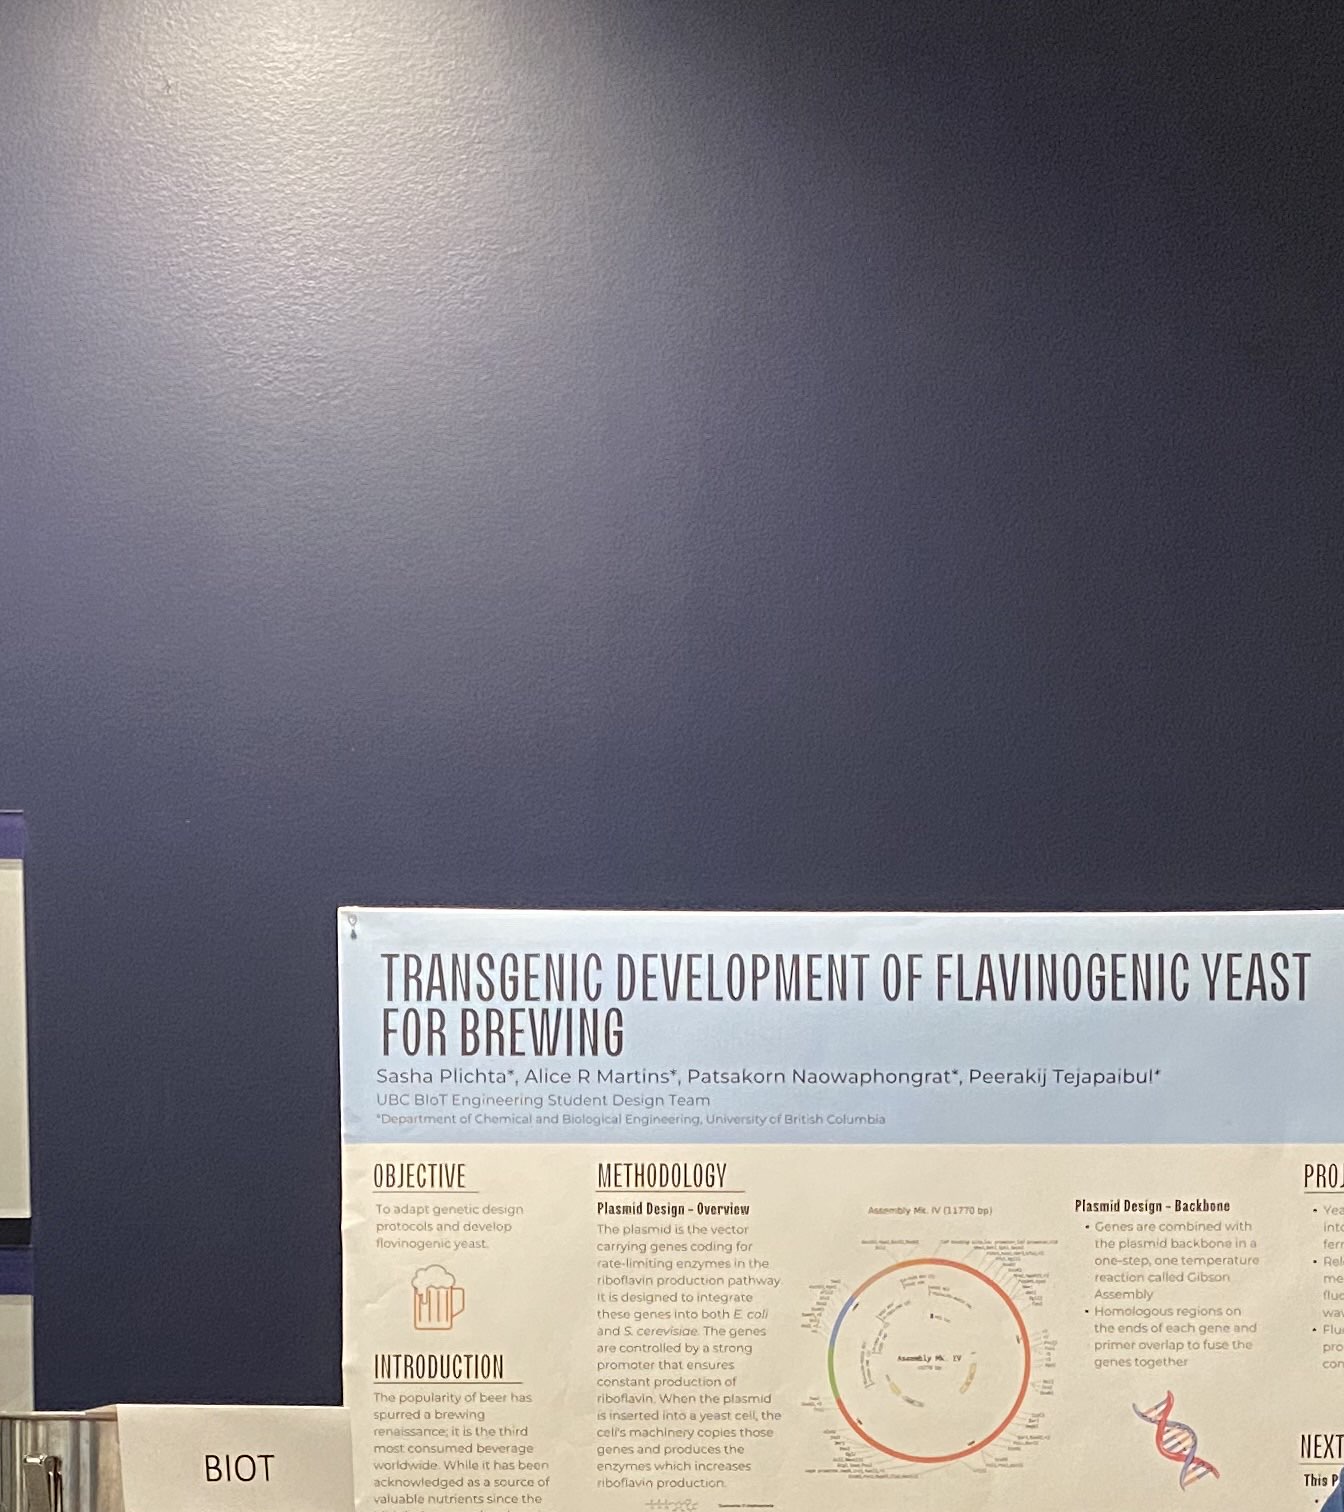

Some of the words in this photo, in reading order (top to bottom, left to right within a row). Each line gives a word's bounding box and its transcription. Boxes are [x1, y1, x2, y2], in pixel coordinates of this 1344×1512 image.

[381, 953, 602, 1001] TRANSGENIC
[618, 954, 869, 1001] DEVELOPMENT
[883, 954, 922, 1001] OF
[938, 953, 1189, 1001] FLAVINOGENIC
[1202, 952, 1311, 1001] YEAST
[384, 1008, 446, 1056] FOR
[462, 1008, 623, 1056] BREWING
[377, 1069, 432, 1083] Sasha
[525, 1069, 571, 1083] Alice
[579, 1069, 589, 1083] R
[689, 1069, 785, 1083] Patsakorn
[970, 1069, 1046, 1087] Peerakij
[377, 1094, 409, 1105] UBC
[453, 1094, 543, 1109] Engineering
[548, 1094, 607, 1106] Student
[613, 1094, 664, 1109] Design
[669, 1094, 710, 1106] Team
[460, 1114, 472, 1124] of
[475, 1113, 532, 1124] Chemical
[536, 1114, 558, 1124] and
[563, 1114, 621, 1126] Biological
[706, 1114, 767, 1126] University
[769, 1114, 782, 1125] of
[785, 1114, 823, 1125] British
[827, 1114, 885, 1124] Columbia
[374, 1164, 465, 1188] OBJECTIVE
[599, 1163, 726, 1187] METHODOLOGY
[376, 1204, 390, 1214] To
[394, 1204, 429, 1216] adapt
[433, 1204, 479, 1216] genetic
[482, 1204, 523, 1216] design
[598, 1202, 642, 1214] Plasmid
[647, 1202, 684, 1217] Design
[697, 1202, 749, 1215] Overview
[868, 1207, 911, 1215] Assembly
[1076, 1200, 1120, 1211] Plasmid
[1125, 1200, 1161, 1214] Design
[1175, 1199, 1229, 1211] Backbone
[376, 1222, 433, 1233] protocols
[437, 1221, 459, 1231] and
[463, 1222, 512, 1233] develop
[1095, 1222, 1133, 1232] Genes
[1159, 1221, 1221, 1231] combined
[1225, 1221, 1252, 1231] with
[375, 1354, 502, 1379] INTRODUCTION
[374, 1392, 395, 1402] The
[400, 1393, 461, 1404] popularity
[465, 1392, 476, 1402] of
[480, 1393, 506, 1402] beer
[511, 1393, 532, 1402] has
[1301, 1434, 1344, 1459] NEXT
[205, 1454, 275, 1482] BIOT
[1304, 1474, 1328, 1486] This
